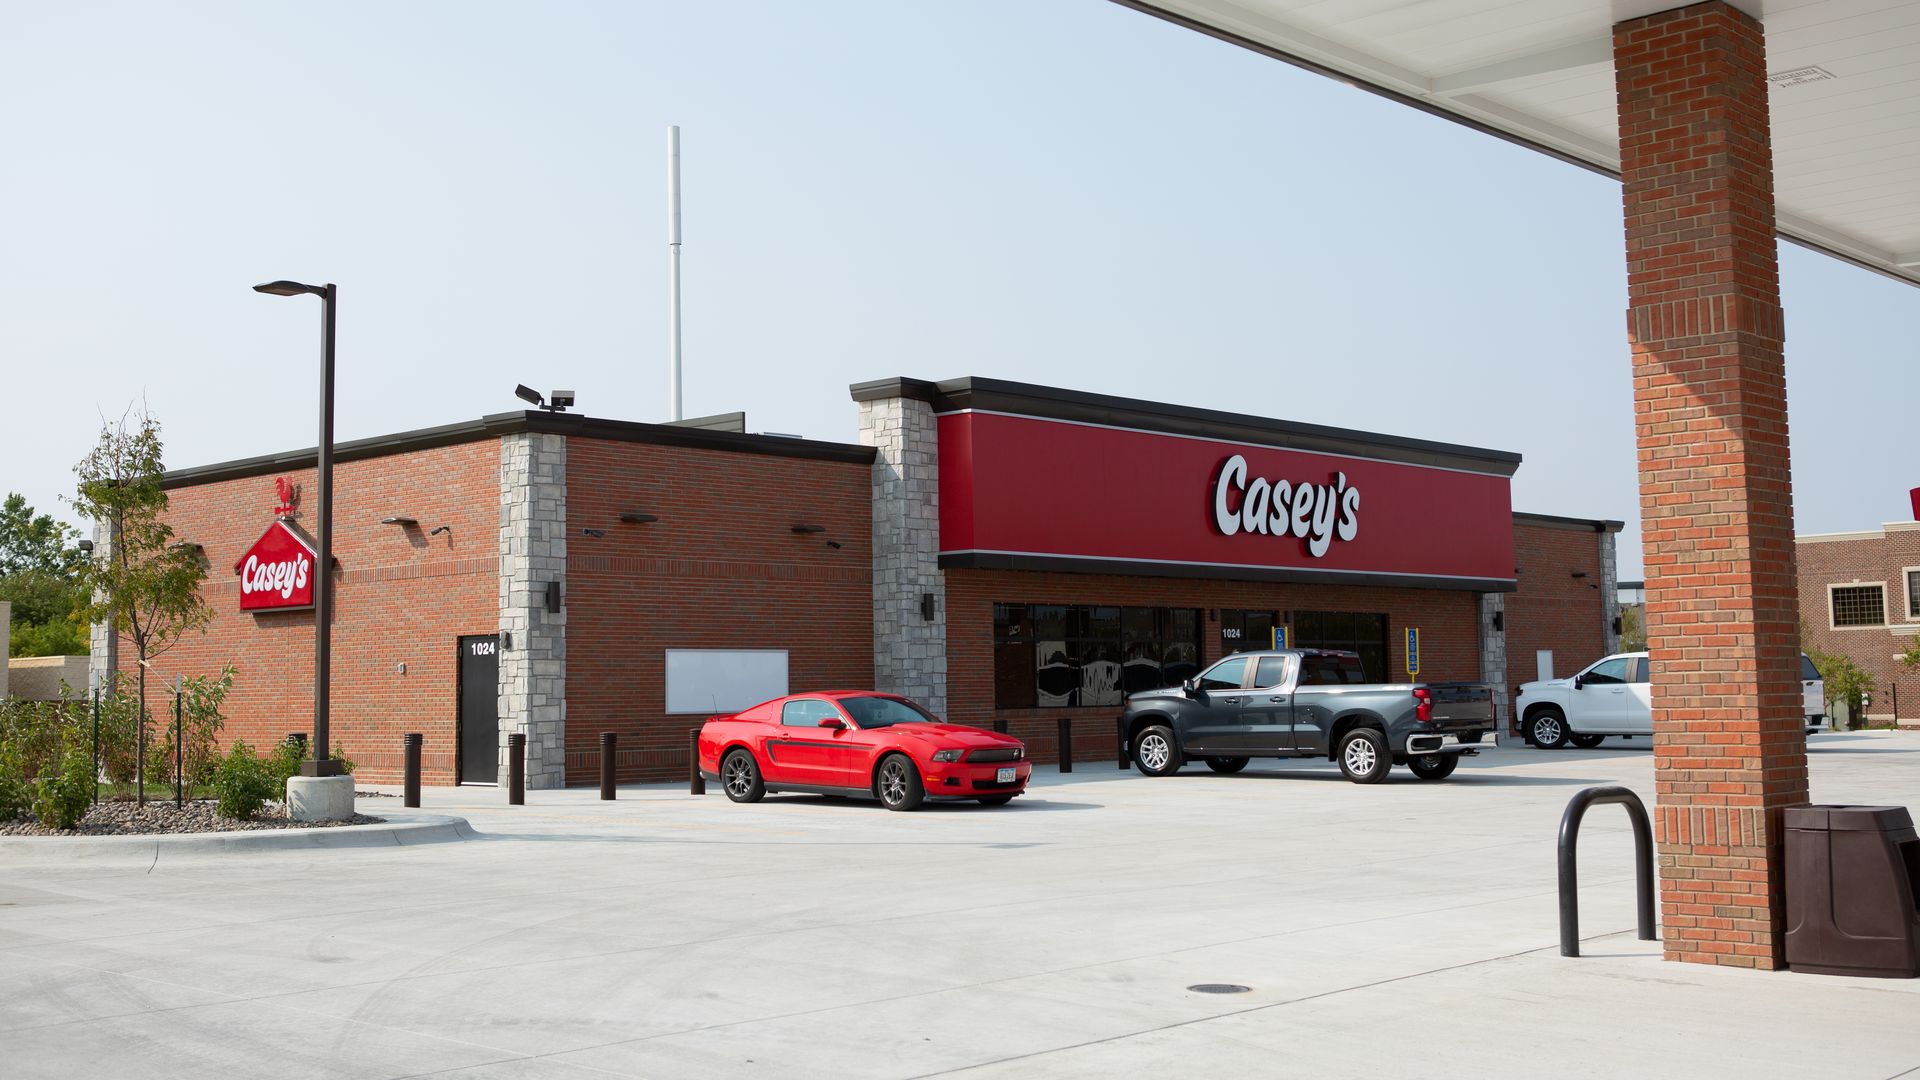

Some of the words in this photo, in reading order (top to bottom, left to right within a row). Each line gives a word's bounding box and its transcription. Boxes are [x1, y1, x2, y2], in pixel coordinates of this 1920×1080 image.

[1216, 455, 1360, 557] Casey's
[242, 553, 309, 599] Casey's
[1222, 628, 1241, 638] 1024
[471, 642, 495, 655] 1024
